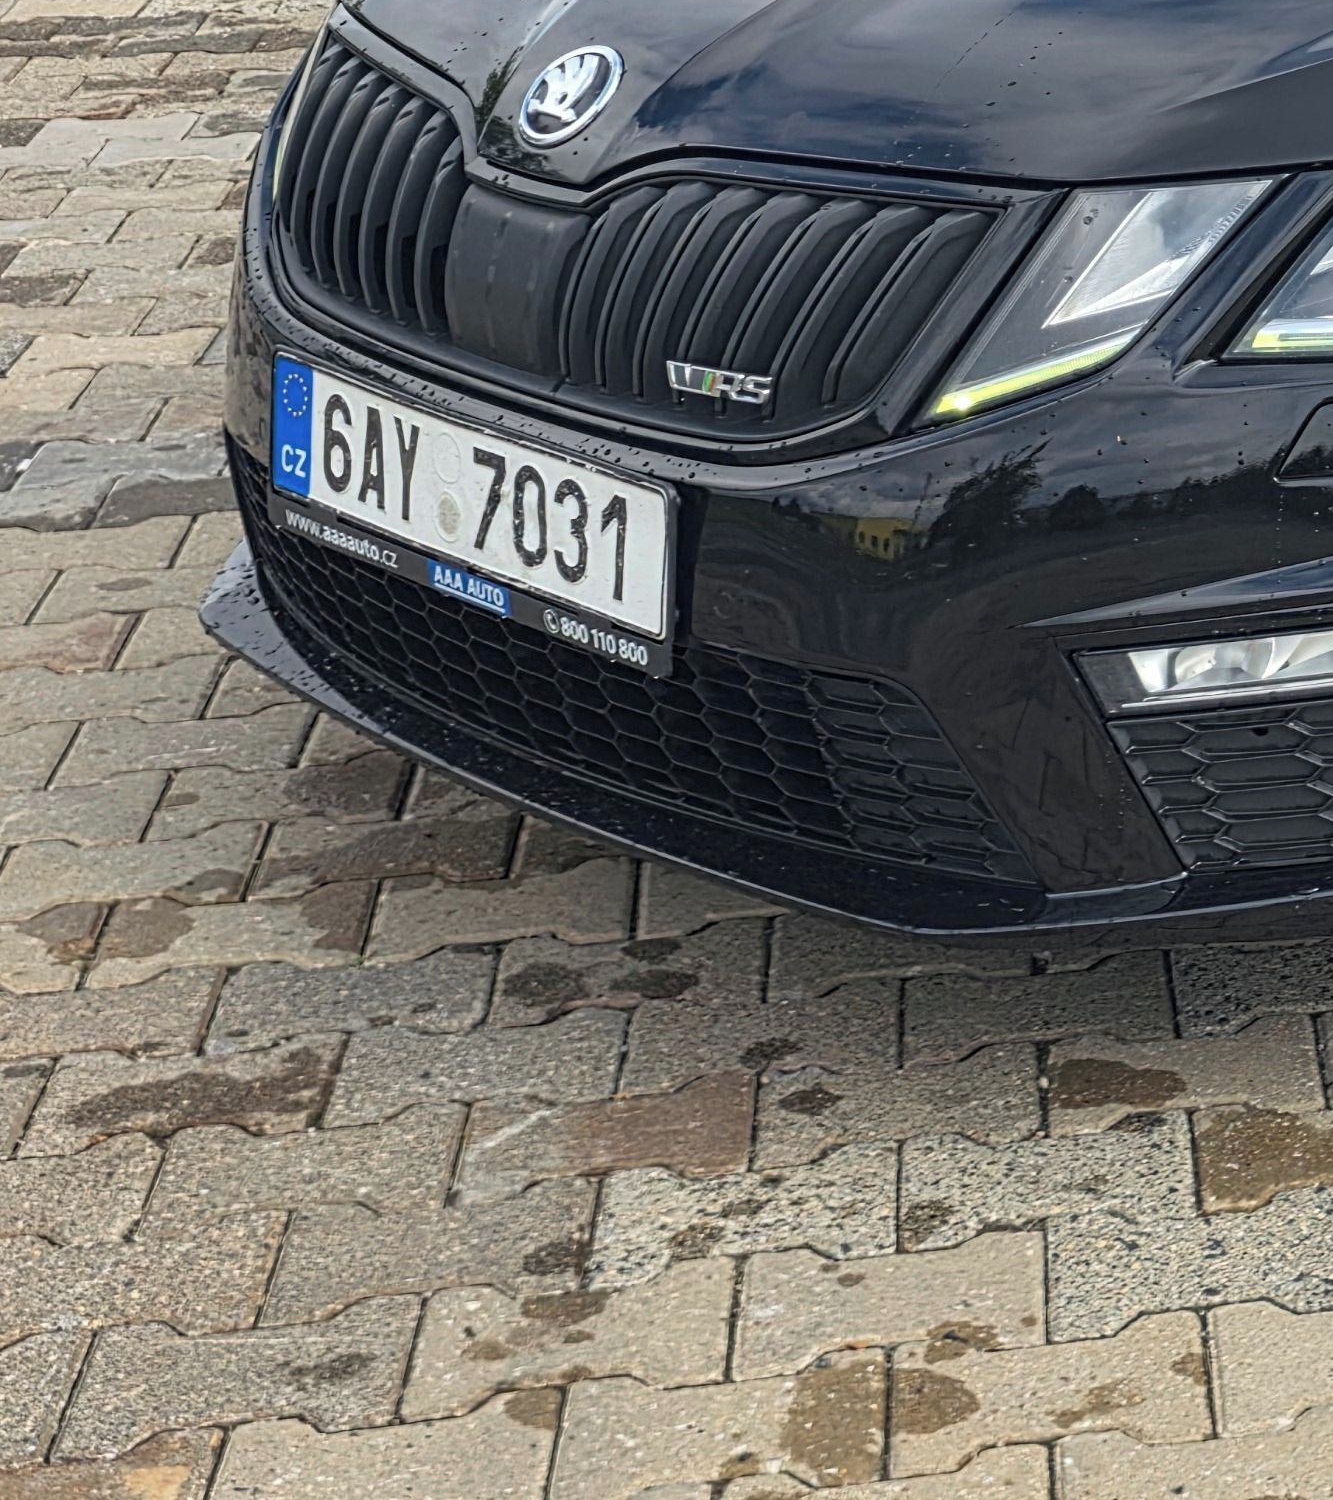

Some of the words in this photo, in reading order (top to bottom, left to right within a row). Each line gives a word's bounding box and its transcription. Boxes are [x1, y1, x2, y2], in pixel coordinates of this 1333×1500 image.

[281, 443, 307, 478] CZ
[321, 393, 419, 522] 6AY
[473, 446, 628, 601] 7031
[434, 565, 463, 592] AAA
[467, 579, 505, 607] AUTO
[560, 616, 589, 644] 800
[591, 628, 616, 655] 110
[619, 641, 648, 667] 800
